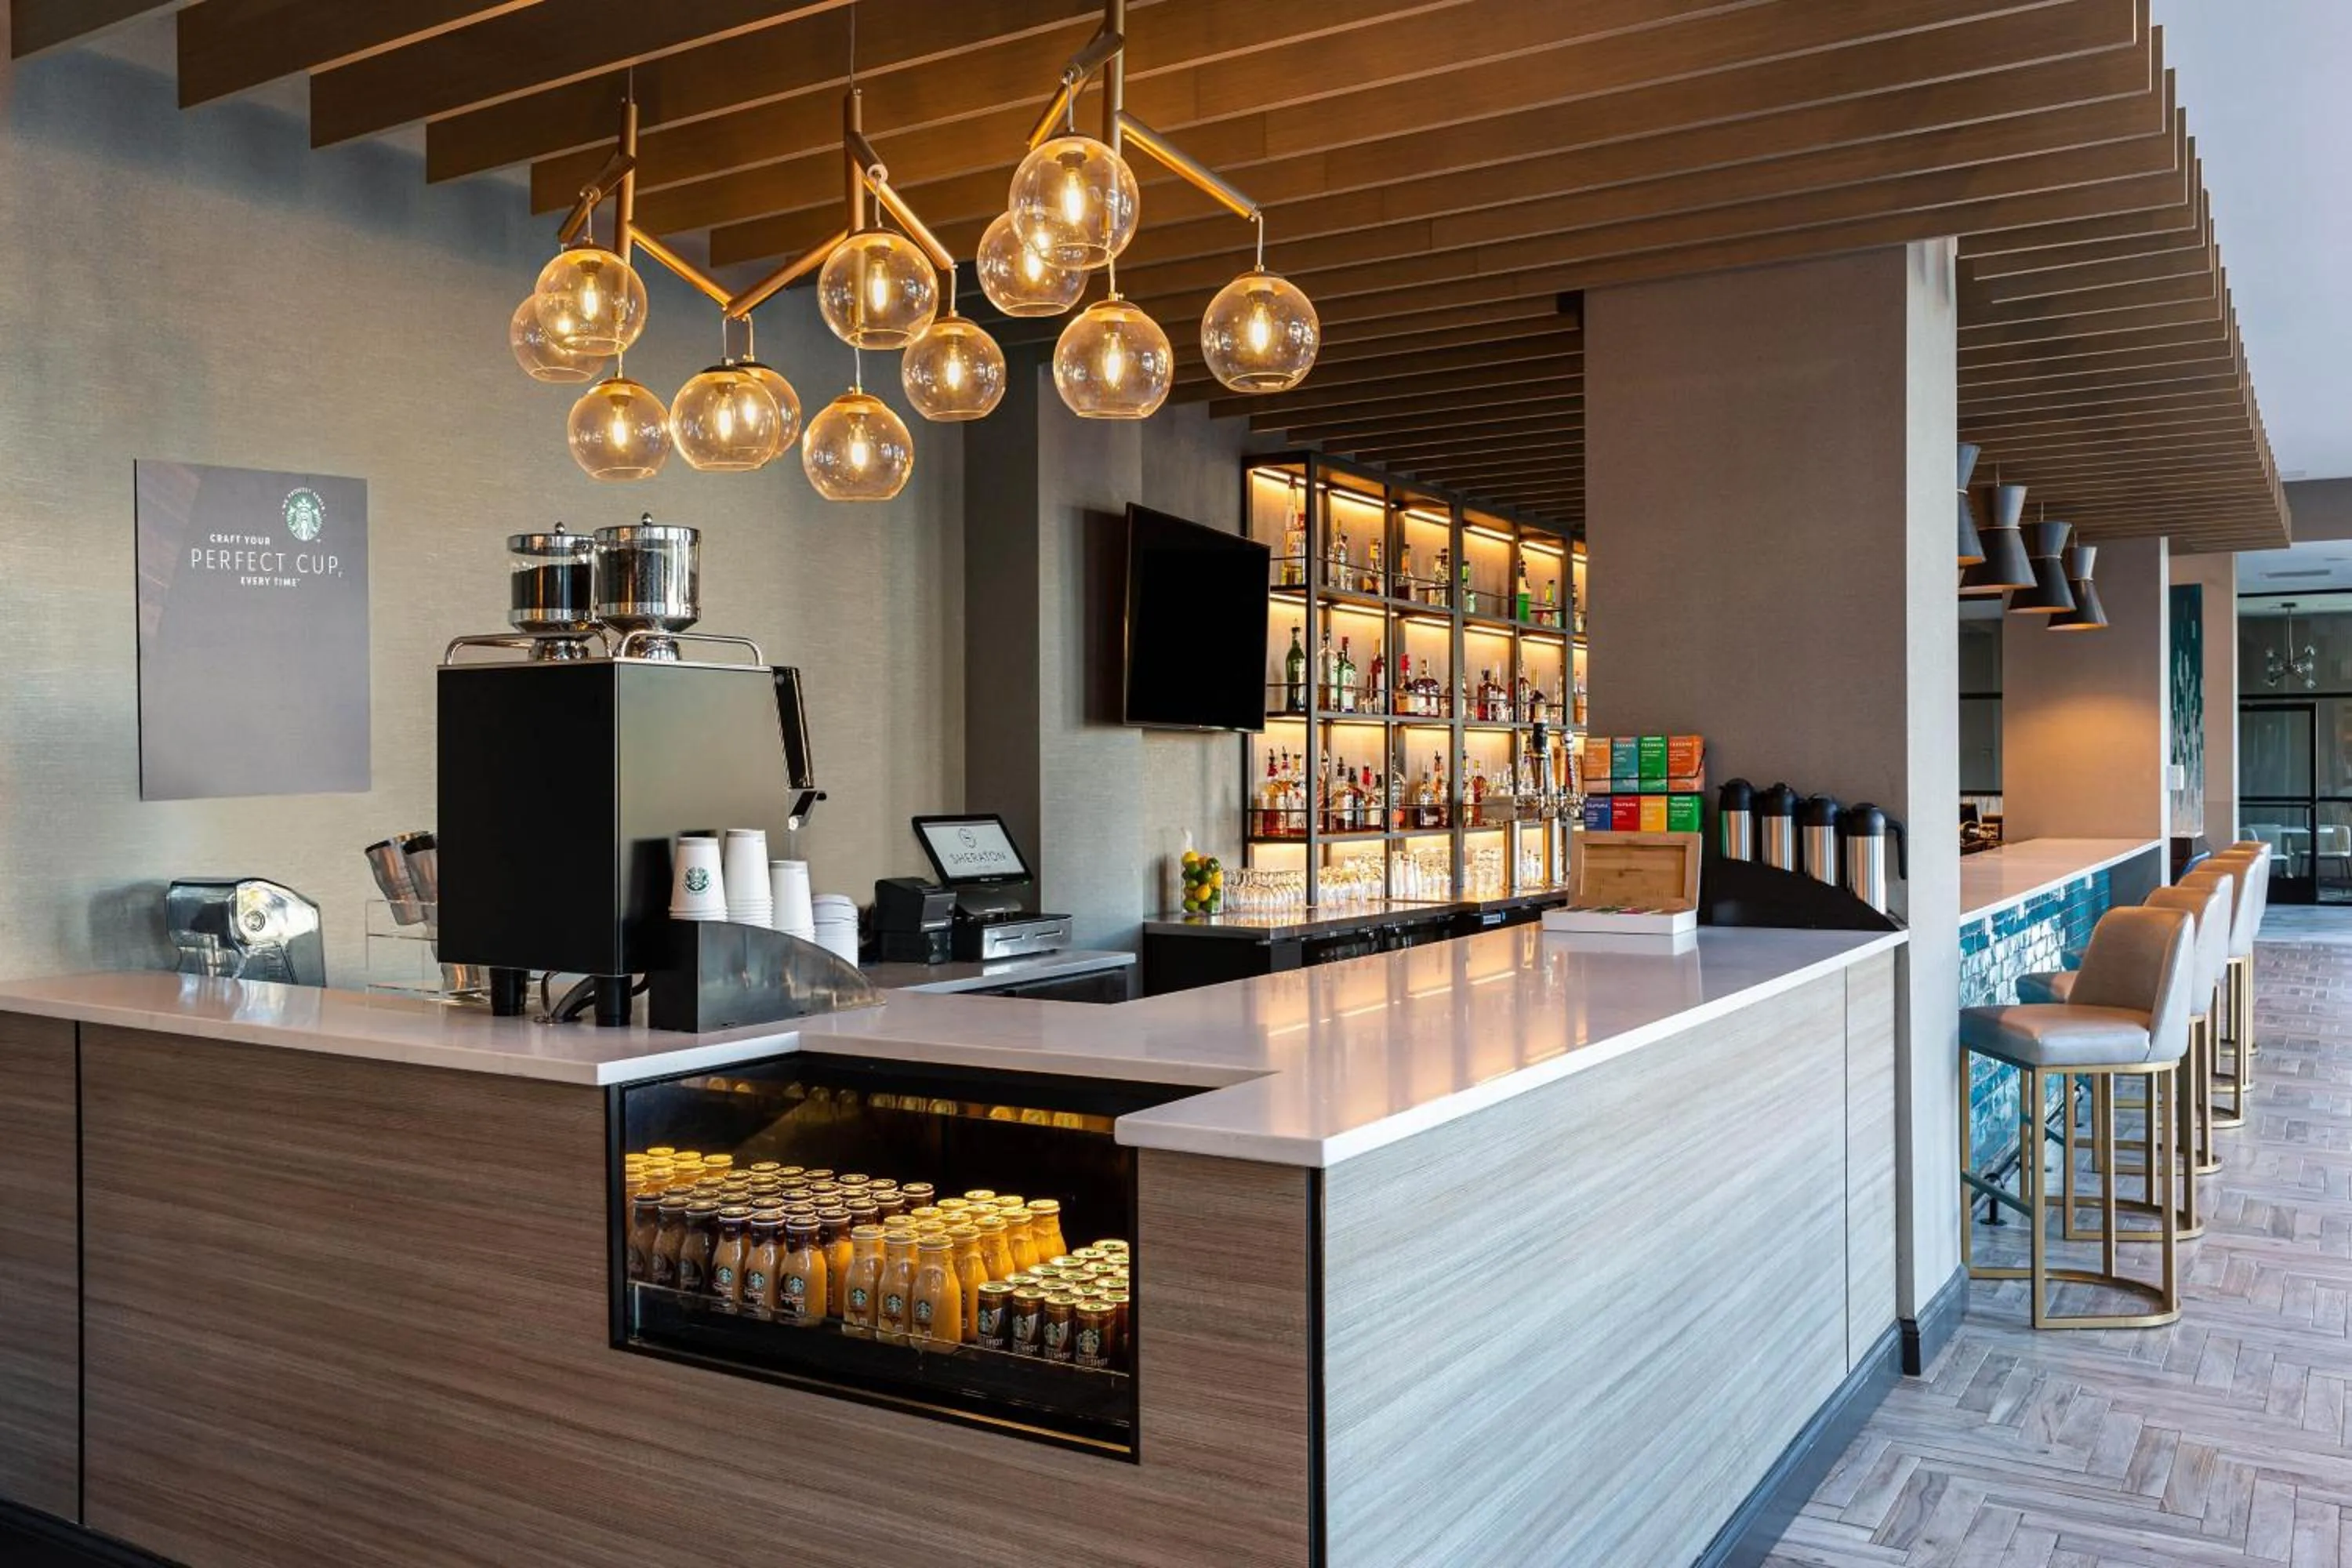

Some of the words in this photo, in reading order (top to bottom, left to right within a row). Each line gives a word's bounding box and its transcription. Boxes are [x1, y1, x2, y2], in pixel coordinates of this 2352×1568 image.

[209, 533, 241, 545] CRAFT
[244, 535, 271, 546] YOUR
[190, 548, 286, 573] PERFECT
[240, 576, 271, 586] EVERY
[949, 851, 1007, 865] SHERATON
